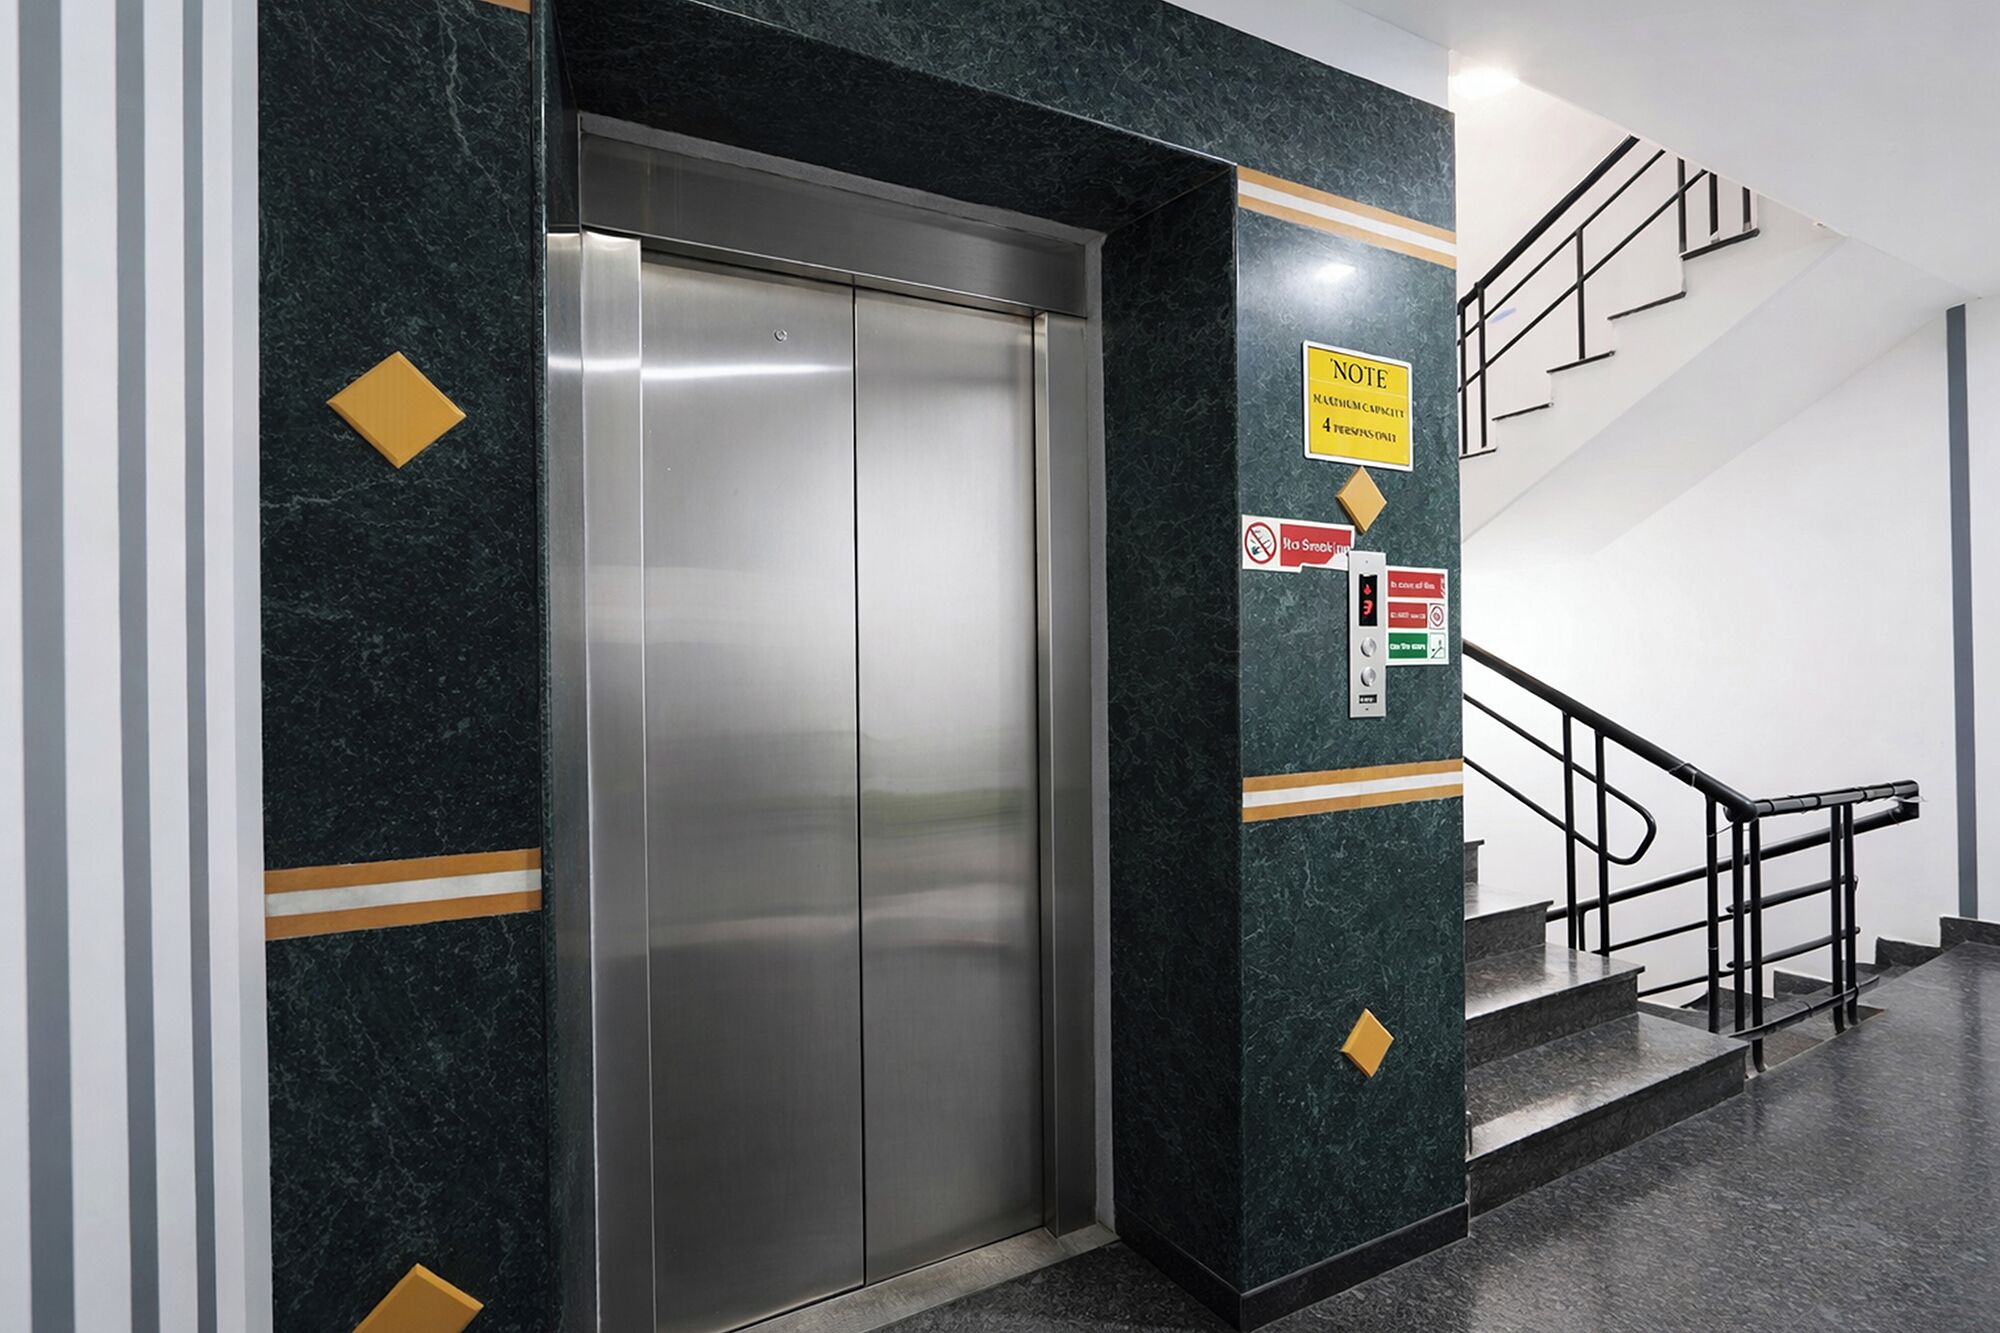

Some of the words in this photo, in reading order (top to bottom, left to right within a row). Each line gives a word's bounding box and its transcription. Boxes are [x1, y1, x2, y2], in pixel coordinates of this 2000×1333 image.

[1330, 358, 1388, 389] NOTE
[1322, 417, 1331, 433] 4
[1363, 599, 1373, 616] 3
